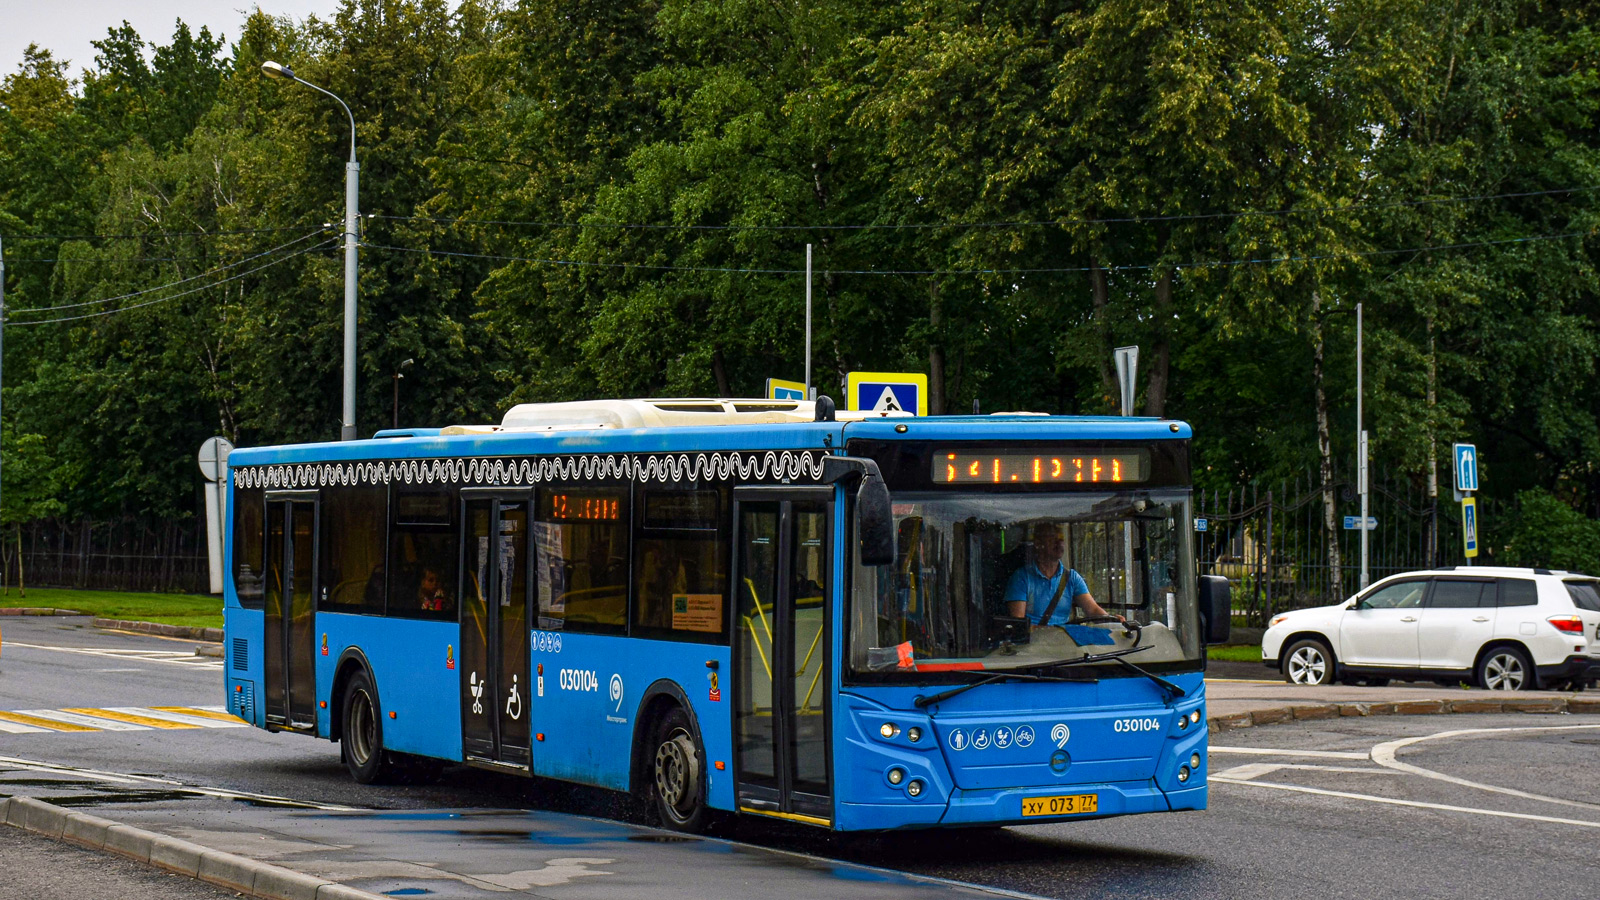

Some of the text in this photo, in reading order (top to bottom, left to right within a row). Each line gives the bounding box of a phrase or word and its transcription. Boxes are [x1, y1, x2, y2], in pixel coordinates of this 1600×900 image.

[560, 668, 599, 692] 030104
[1114, 718, 1160, 732] 030104
[1050, 797, 1074, 812] 073
[1081, 795, 1093, 807] 77
